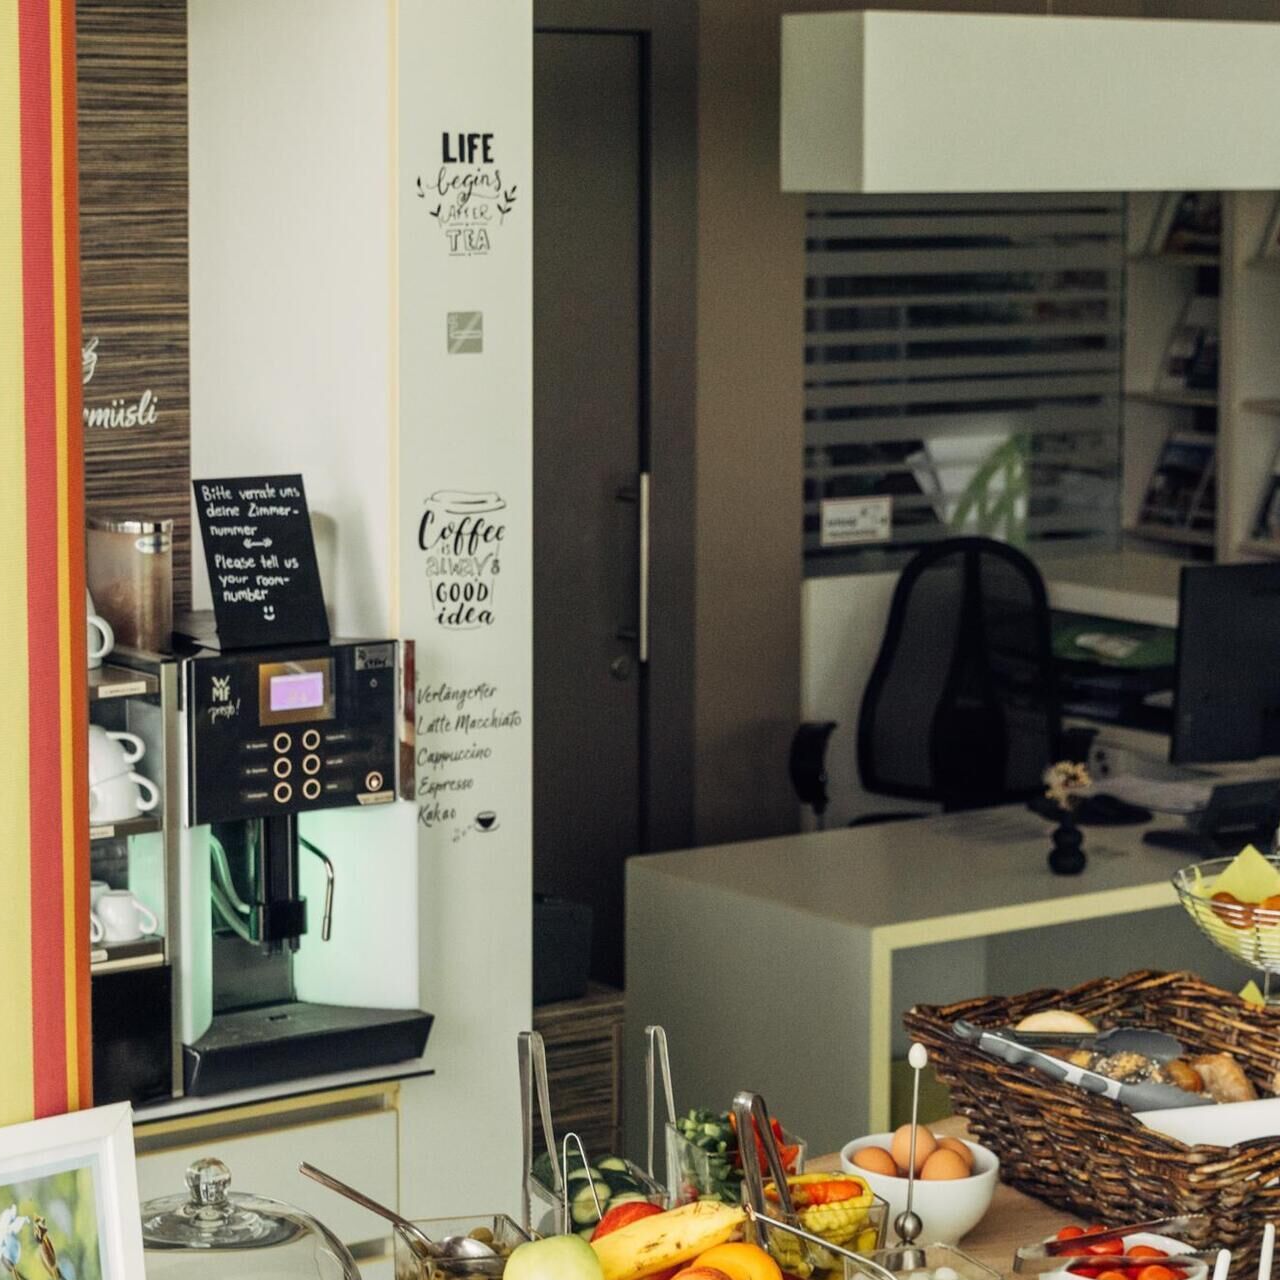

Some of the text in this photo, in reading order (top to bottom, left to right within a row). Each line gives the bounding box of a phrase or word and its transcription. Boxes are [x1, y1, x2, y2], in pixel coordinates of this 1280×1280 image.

[442, 131, 494, 164] LIFE
[431, 166, 501, 207] begins
[445, 228, 490, 252] TEA
[201, 482, 300, 502] Bitte verrate uns
[206, 502, 299, 518] deine Zimmer-
[209, 525, 258, 536] nummer
[418, 510, 506, 556] Coffee
[214, 553, 299, 570] Please tell us
[218, 575, 290, 588] your room-
[436, 582, 489, 603] GOOD
[223, 587, 268, 603] number
[437, 602, 495, 625] idea
[416, 708, 522, 736] Latte Macchiato
[416, 742, 492, 771] Cappuccino
[417, 776, 474, 799] Espresso
[416, 802, 456, 828] Kakao
